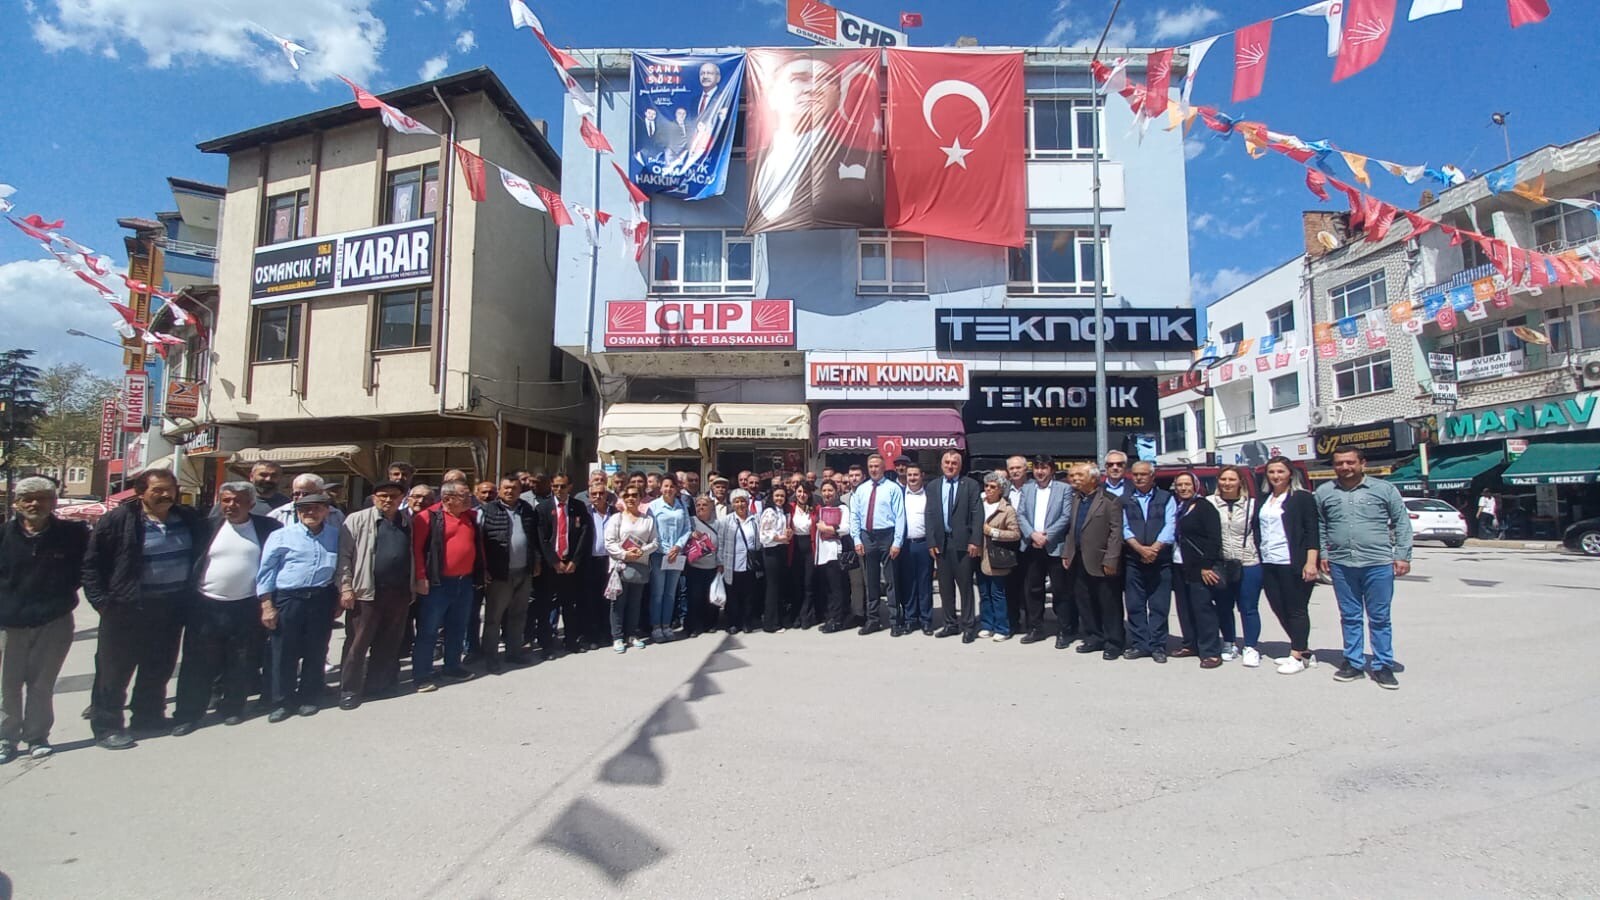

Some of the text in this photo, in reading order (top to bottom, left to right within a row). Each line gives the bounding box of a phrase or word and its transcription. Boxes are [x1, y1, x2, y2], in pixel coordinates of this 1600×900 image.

[841, 18, 897, 47] CHP
[648, 64, 680, 74] SANA
[343, 231, 430, 280] KARAR
[255, 255, 332, 285] OSMANCIK FM
[655, 303, 744, 331] CHP
[609, 333, 788, 346] OSMANCIK İLÇE BAŞKANLIĞI
[1471, 353, 1508, 366] AVUKAT
[876, 365, 959, 382] KUNDURA
[127, 378, 145, 424] MARKET
[1032, 416, 1144, 427] TELEFON RSASI
[1445, 395, 1598, 439] MANAV
[714, 427, 735, 437] AKSU
[736, 427, 766, 437] BERBER
[828, 436, 958, 447] METİN UNDURA
[1511, 477, 1538, 485] TAZE
[1548, 475, 1585, 484] SEBZE
